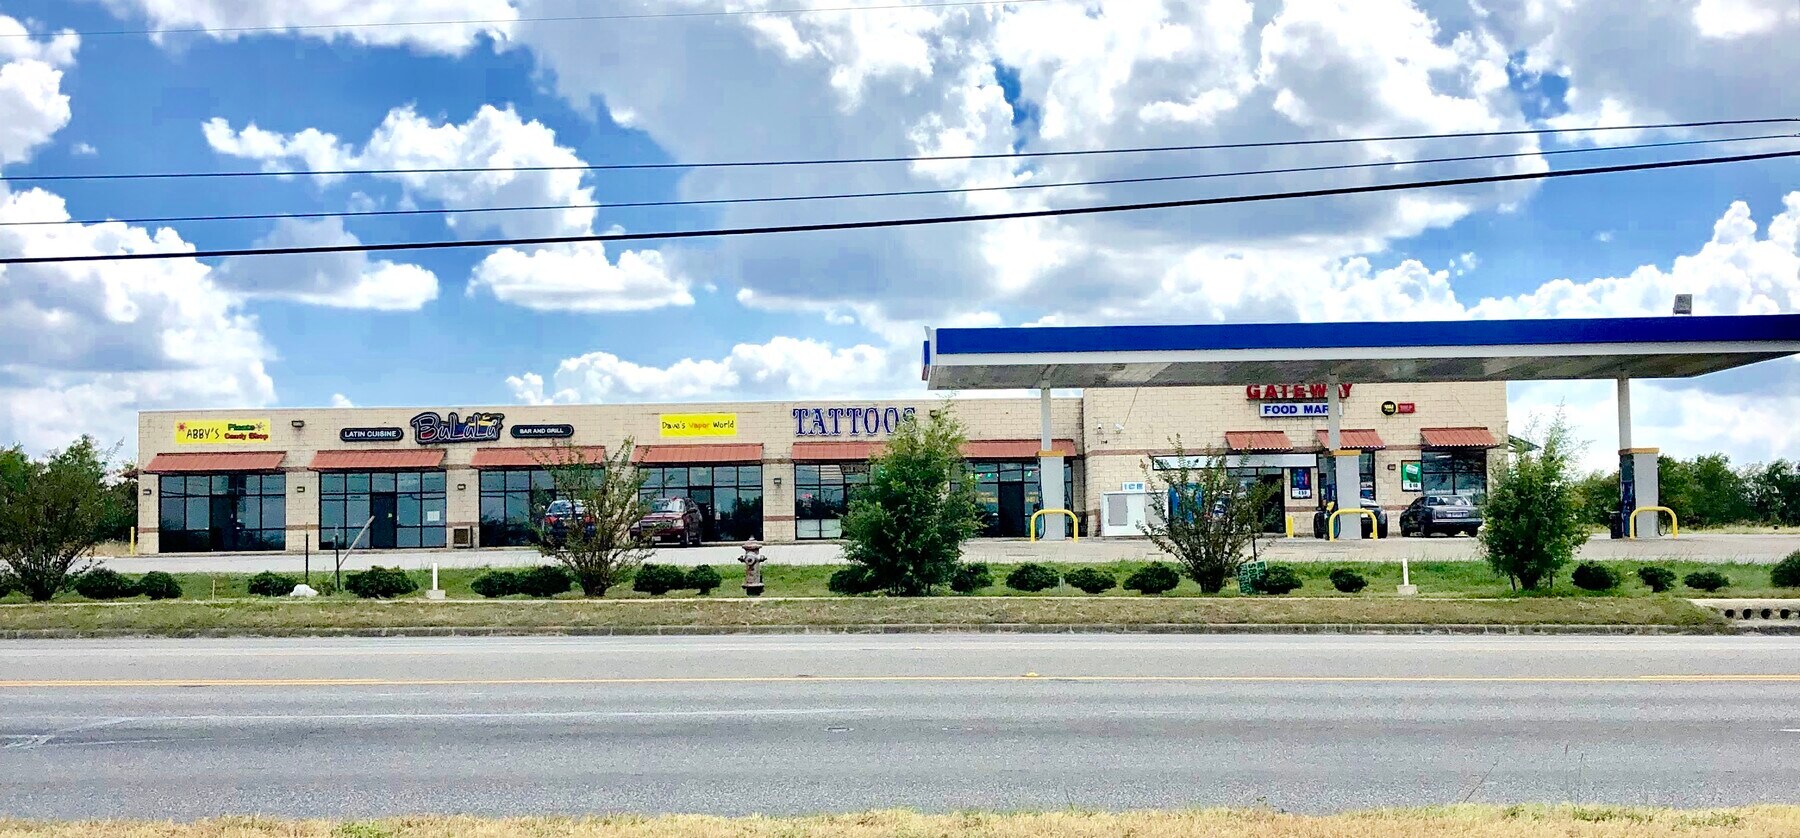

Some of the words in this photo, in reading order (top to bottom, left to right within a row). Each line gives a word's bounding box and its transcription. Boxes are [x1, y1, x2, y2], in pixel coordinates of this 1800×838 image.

[1246, 384, 1353, 399] GATEWY
[1264, 405, 1297, 414] FOOD
[1304, 404, 1328, 414] MAR
[662, 420, 686, 429] Dave's
[713, 420, 734, 428] World
[793, 407, 915, 436] TATTOOS
[186, 427, 219, 439] ABBY'S
[224, 432, 246, 440] Candy
[248, 432, 269, 440] Shop
